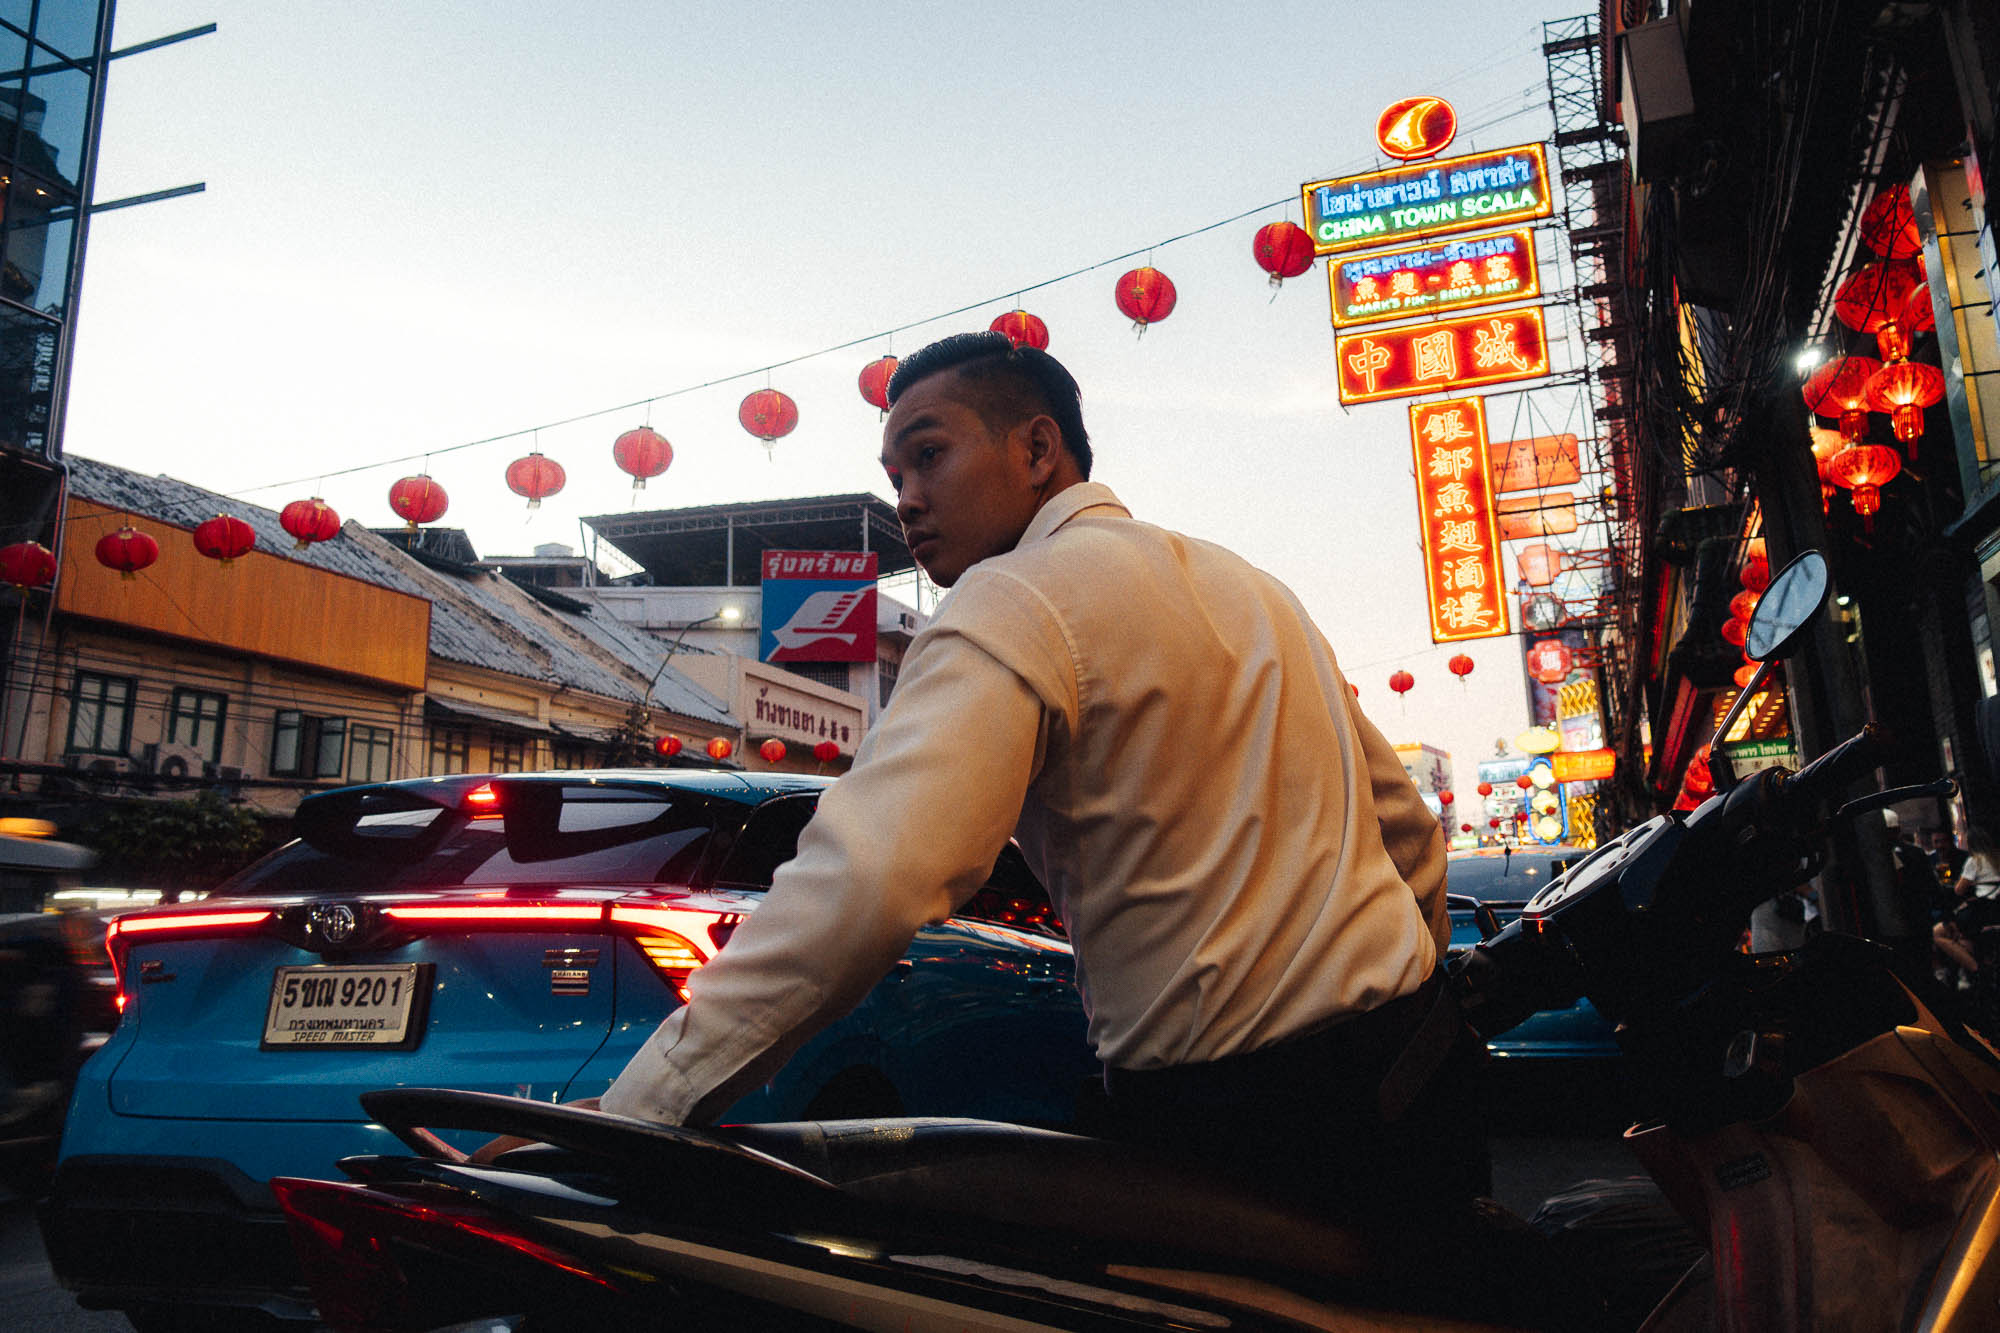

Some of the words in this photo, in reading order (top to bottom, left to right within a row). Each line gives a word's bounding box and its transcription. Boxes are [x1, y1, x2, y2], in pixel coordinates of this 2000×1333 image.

[1319, 214, 1386, 241] CHINA
[1391, 202, 1457, 229] TOWN
[1461, 190, 1537, 216] SCALA
[1347, 297, 1401, 316] SHARK'S
[1439, 284, 1483, 302] BIRD'S
[1485, 278, 1520, 294] NEST
[1348, 319, 1528, 393] 中國城
[1421, 410, 1495, 629] 銀都魚翅酒樓
[340, 976, 403, 1007] 9201
[289, 1018, 385, 1031] กรงเทพมหานคร
[292, 1032, 328, 1042] SPEED
[330, 1031, 375, 1041] MASTER
